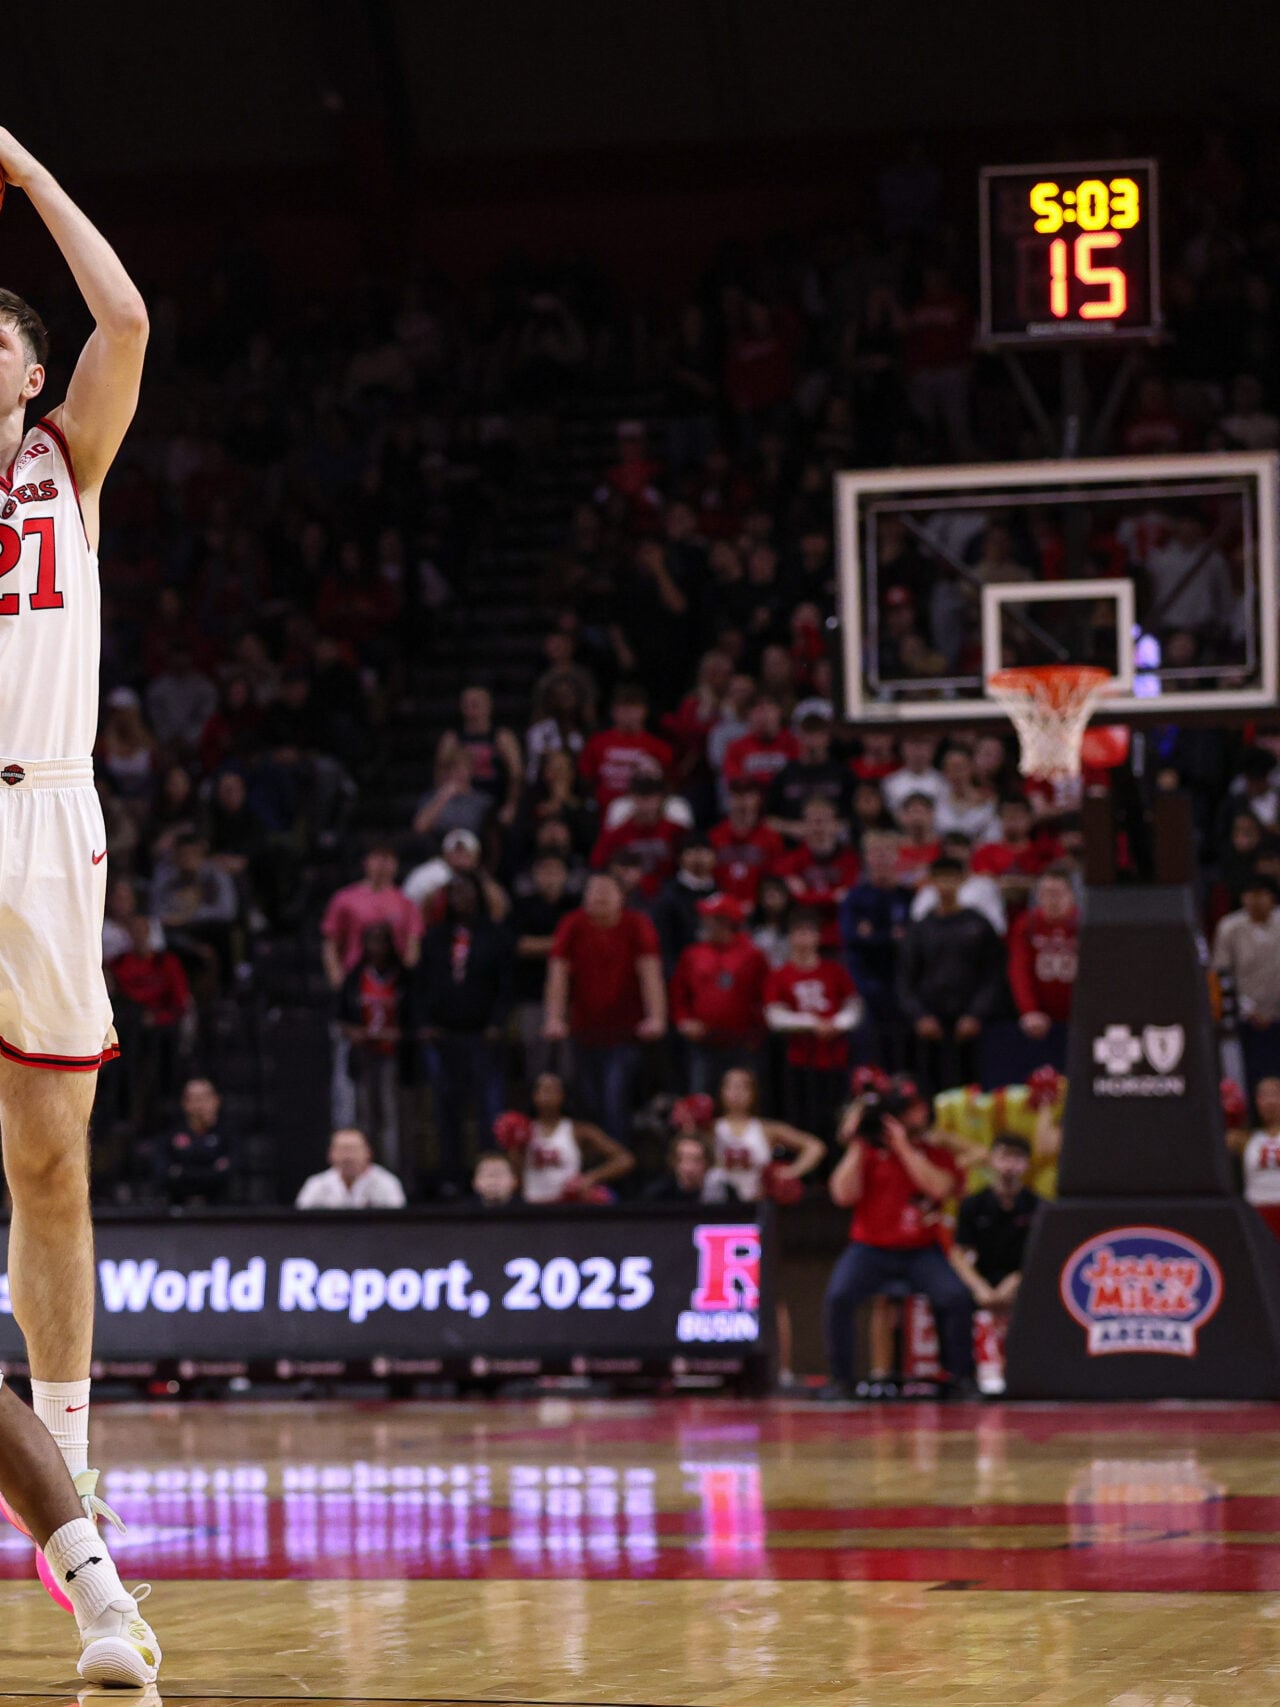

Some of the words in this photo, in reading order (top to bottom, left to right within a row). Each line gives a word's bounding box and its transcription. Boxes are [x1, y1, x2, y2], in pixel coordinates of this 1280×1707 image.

[1030, 178, 1139, 233] 5:03
[1050, 231, 1127, 319] 15
[1093, 1075, 1185, 1097] HORIZON
[99, 1256, 266, 1313] World
[278, 1257, 490, 1323] Report,
[503, 1256, 654, 1311] 2025
[1083, 1247, 1200, 1288] Jersey
